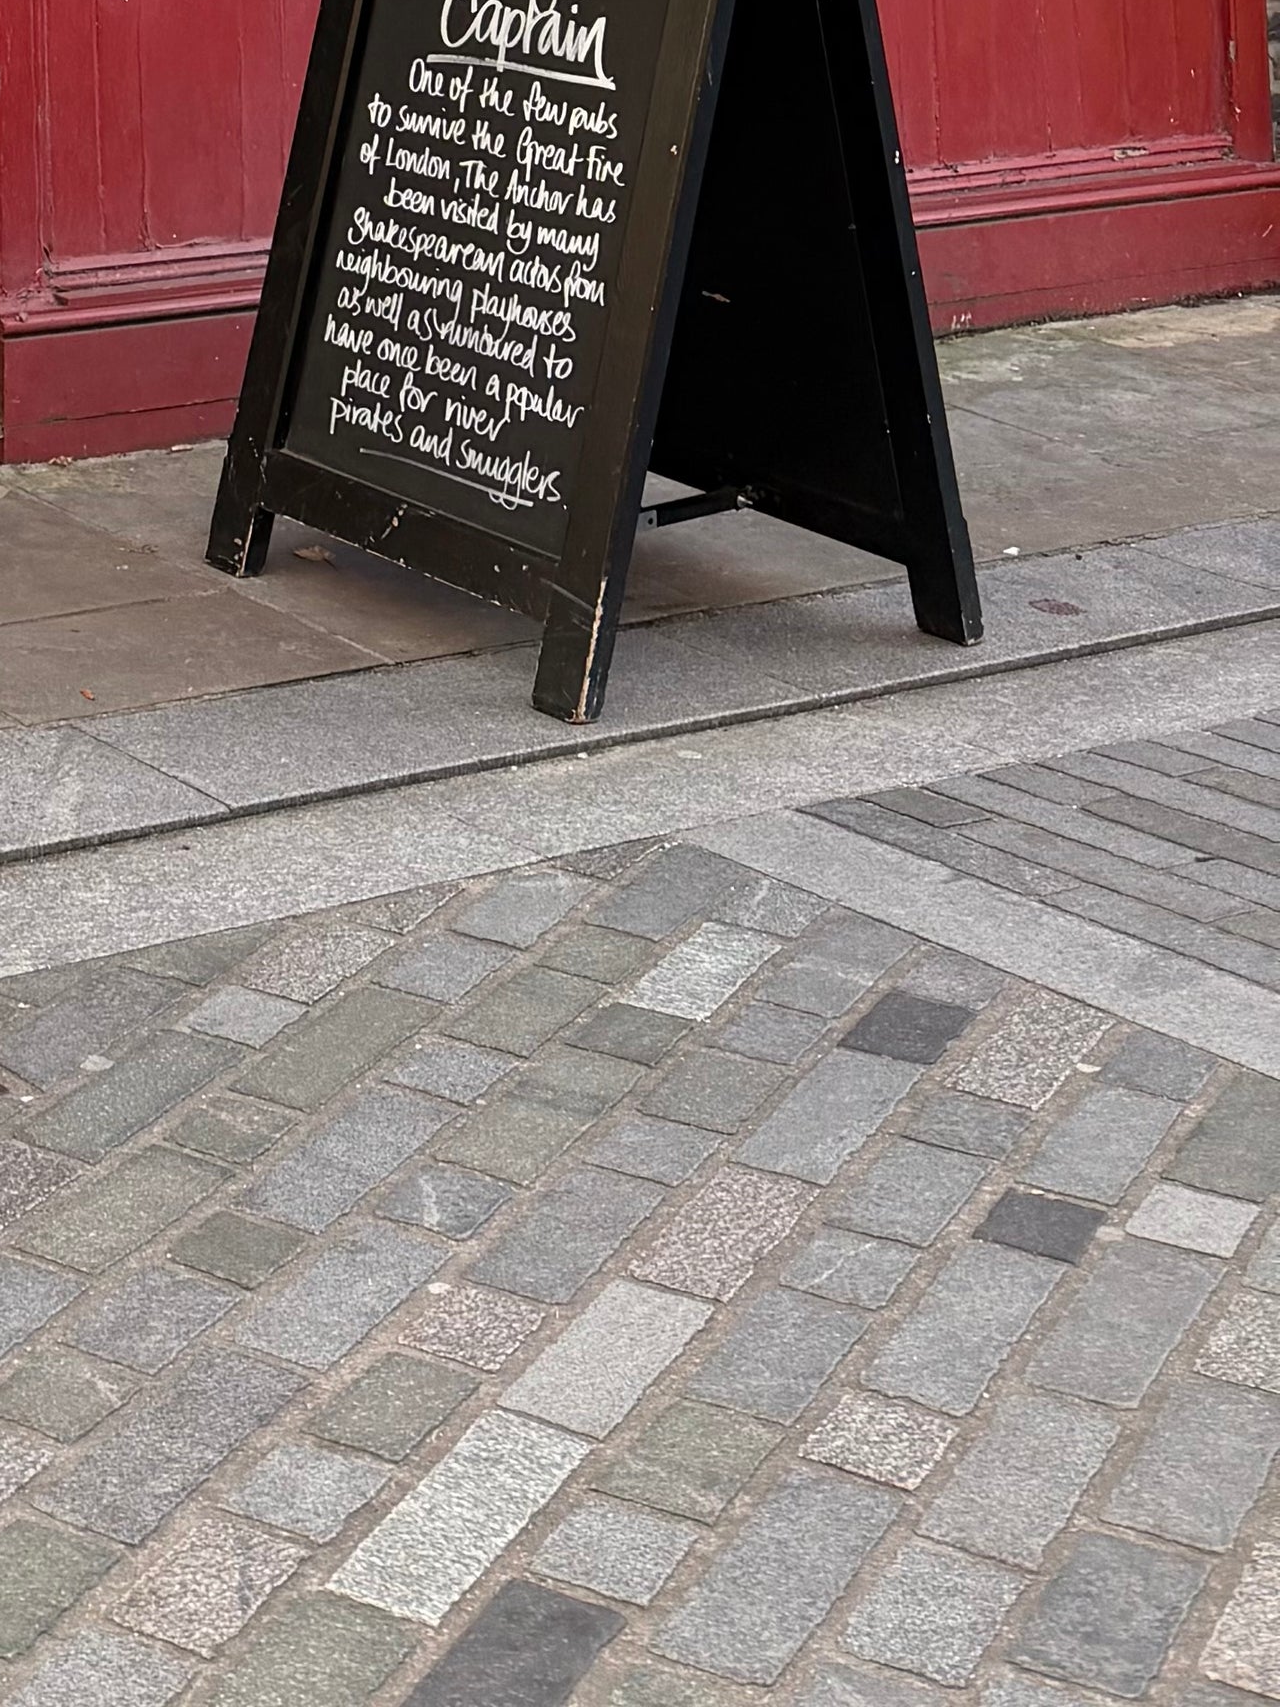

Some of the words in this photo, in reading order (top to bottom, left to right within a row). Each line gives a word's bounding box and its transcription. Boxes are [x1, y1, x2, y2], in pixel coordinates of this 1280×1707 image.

[367, 92, 391, 128] to
[472, 119, 507, 158] the
[516, 126, 584, 182] Great
[409, 58, 444, 97] One
[449, 66, 473, 113] of
[479, 77, 515, 117] the
[523, 81, 568, 126] few
[568, 102, 618, 139] pubs
[360, 134, 381, 175] of
[459, 160, 500, 198] The
[504, 169, 575, 216] Anchor
[576, 185, 617, 224] has
[383, 177, 435, 216] been
[440, 193, 500, 235] visited
[506, 209, 532, 255] by
[537, 226, 600, 272] many
[336, 248, 463, 319] neighbouring
[470, 283, 577, 342] playhouses
[347, 206, 503, 282] Shakespearean
[562, 261, 605, 308] from
[324, 313, 375, 356] have
[377, 338, 421, 372] once
[425, 344, 477, 391] been
[486, 374, 500, 401] a
[503, 383, 584, 428] popular
[338, 287, 361, 316] as
[365, 292, 404, 332] well
[407, 308, 434, 342] as
[436, 315, 539, 378] rumoured
[542, 343, 573, 380] to
[341, 359, 391, 398] place
[400, 371, 438, 413] for
[445, 395, 506, 441] river
[410, 425, 452, 466] and
